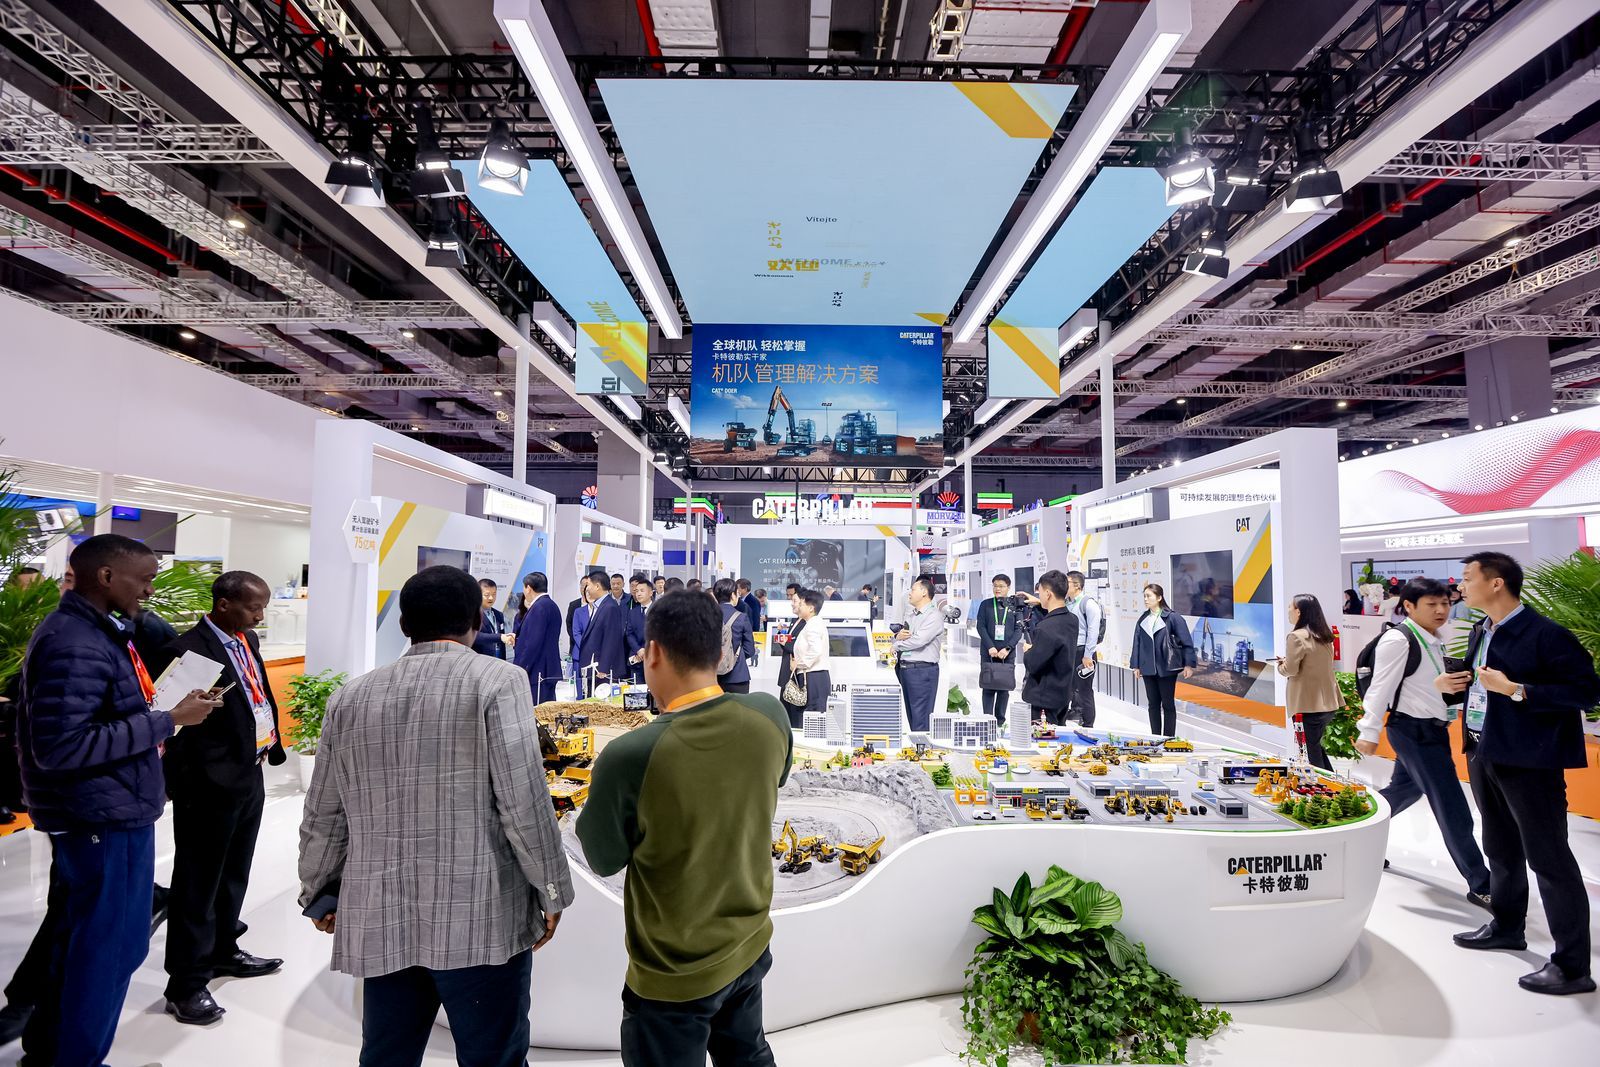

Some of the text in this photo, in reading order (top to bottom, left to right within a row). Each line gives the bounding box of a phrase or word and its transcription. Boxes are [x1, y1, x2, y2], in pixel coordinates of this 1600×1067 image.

[712, 339, 806, 351] 全球机队 轻松掌握
[712, 353, 768, 361] 卡特彼勒实干家
[711, 362, 880, 384] 机队管理解决方案
[1180, 493, 1277, 502] 可持续发展的理想合作伙伴
[752, 497, 873, 519] CATERPILLAR
[1235, 517, 1251, 533] CAT
[1228, 853, 1323, 875] CATERPILLAR
[1243, 874, 1309, 894] 卡特彼勒
